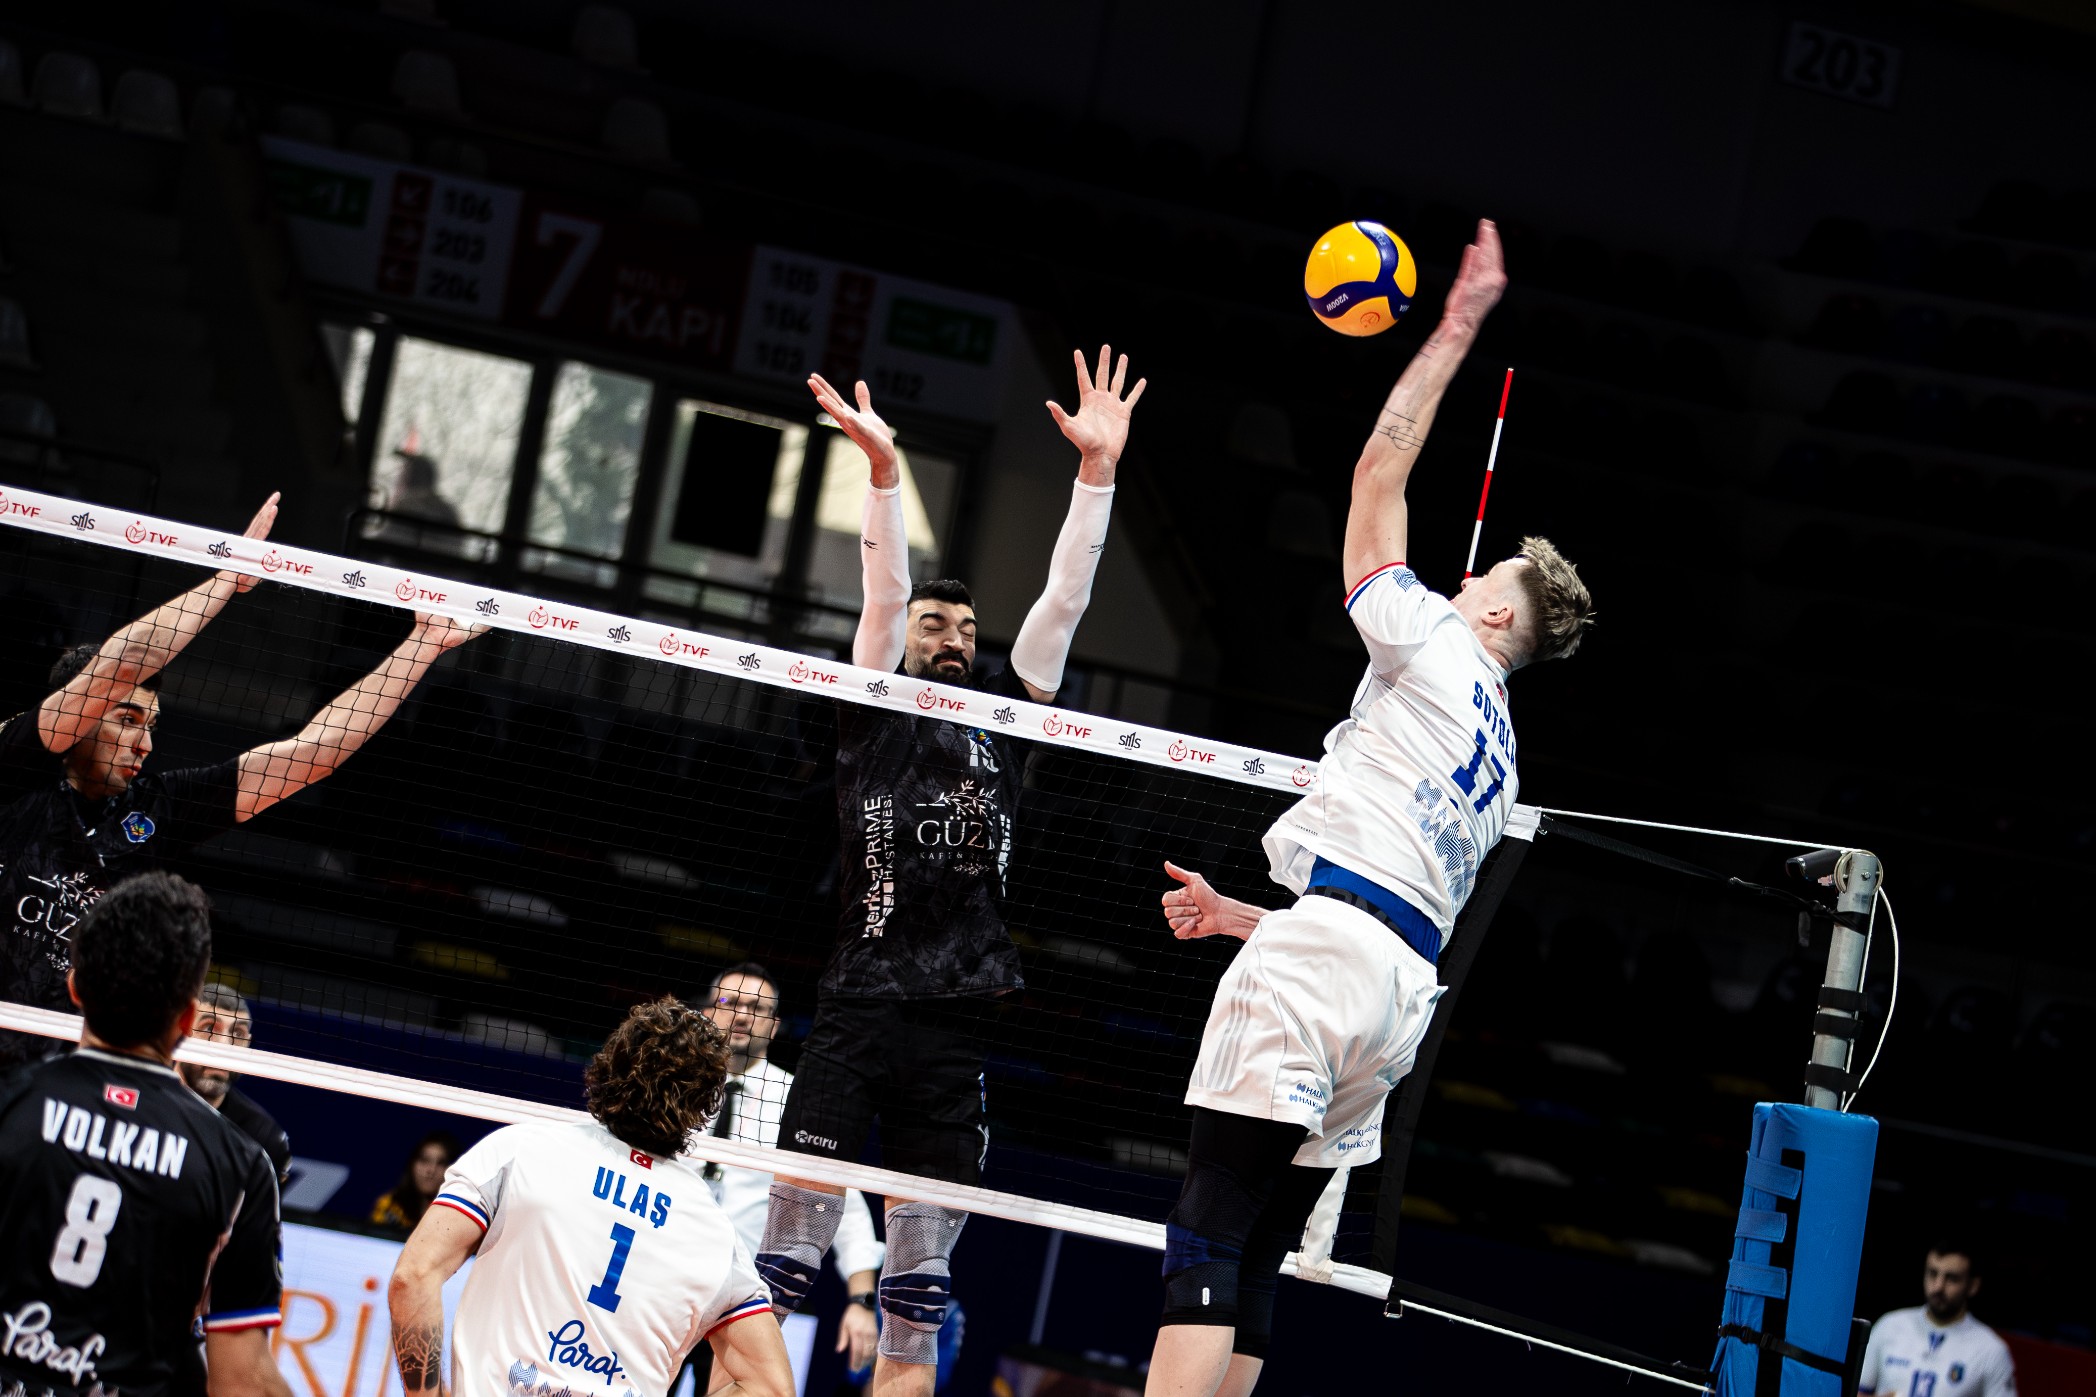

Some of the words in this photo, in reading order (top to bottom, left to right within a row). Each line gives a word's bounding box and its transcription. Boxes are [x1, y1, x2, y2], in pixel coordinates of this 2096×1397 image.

[1796, 32, 1885, 96] 203
[433, 229, 487, 265] 203
[443, 189, 493, 224] 106
[534, 210, 606, 320] 7
[607, 290, 728, 357] KAPI
[11, 502, 41, 518] TVF
[149, 531, 179, 547] TVF
[284, 560, 314, 577] TVF
[419, 589, 447, 604] TVF
[551, 616, 580, 631] TVF
[682, 643, 711, 659] TVF
[811, 670, 839, 685] TVF
[939, 697, 967, 712] TVF
[1065, 723, 1092, 740] TVF
[1189, 749, 1217, 765] TVF
[1451, 728, 1507, 815] 17
[41, 1097, 188, 1180] VOLKAN
[50, 1173, 122, 1289] 8
[592, 1166, 671, 1228] ULAŞ
[587, 1222, 636, 1313] 1
